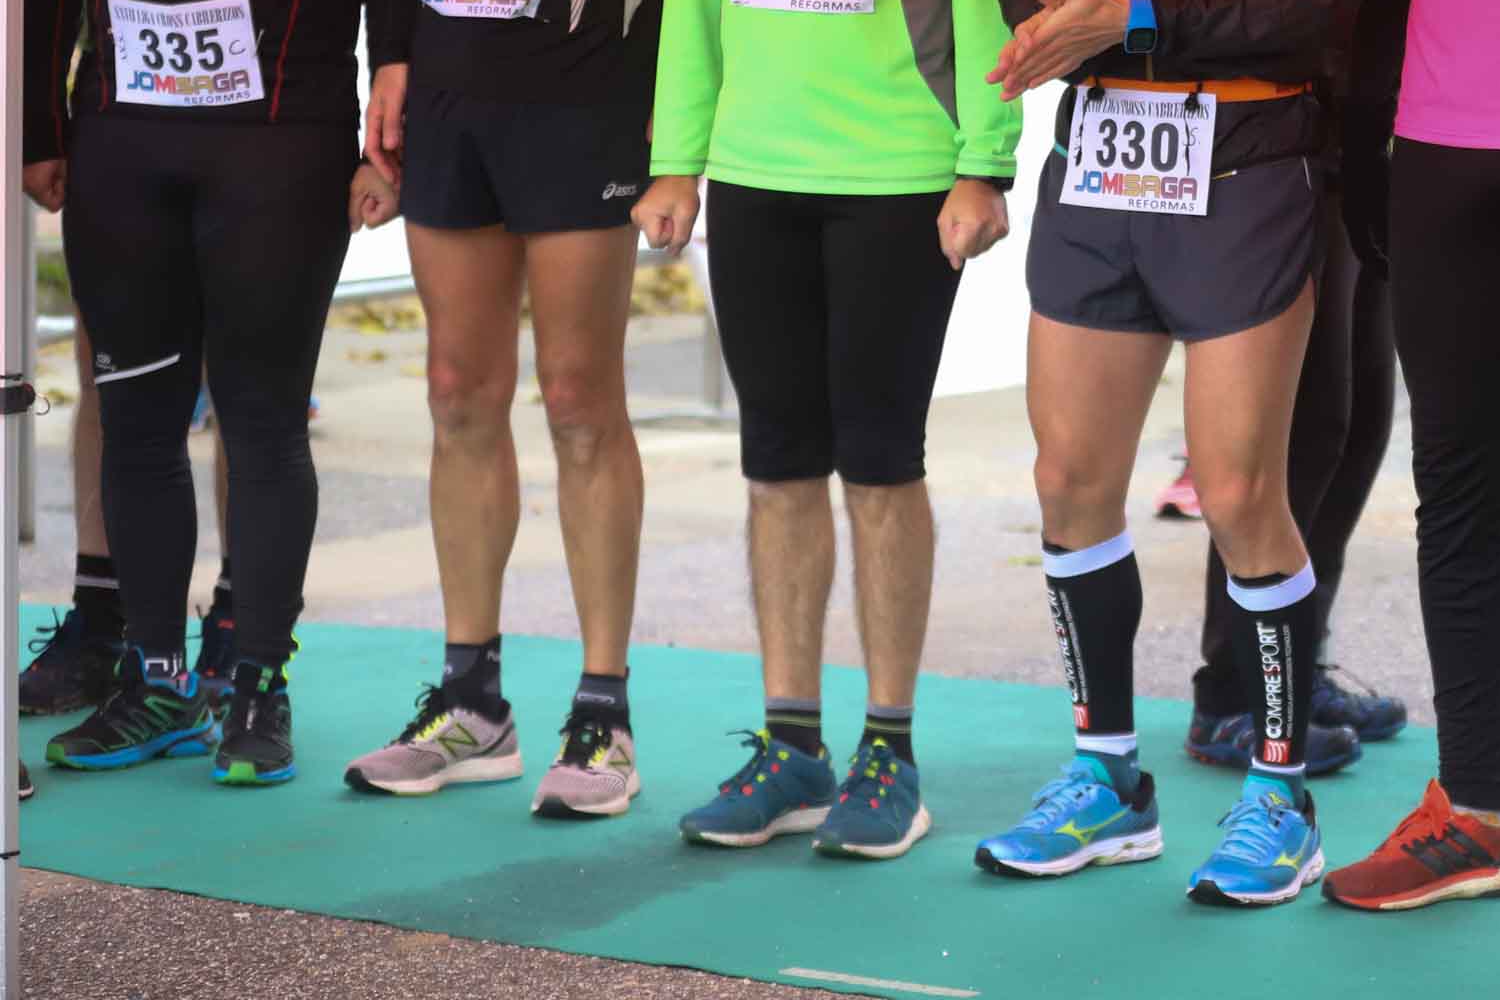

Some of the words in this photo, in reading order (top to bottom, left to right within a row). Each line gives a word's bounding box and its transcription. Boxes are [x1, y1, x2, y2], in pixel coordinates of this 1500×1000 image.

[790, 0, 863, 12] REFORMAS
[138, 28, 225, 74] 335
[126, 69, 251, 95] JOMISAGA
[183, 91, 251, 105] REFORMAS
[1095, 118, 1180, 173] 330
[1073, 169, 1199, 201] JOMISAGA
[1127, 198, 1195, 212] REFORMAS
[1257, 625, 1283, 739] COMPRESPORT
